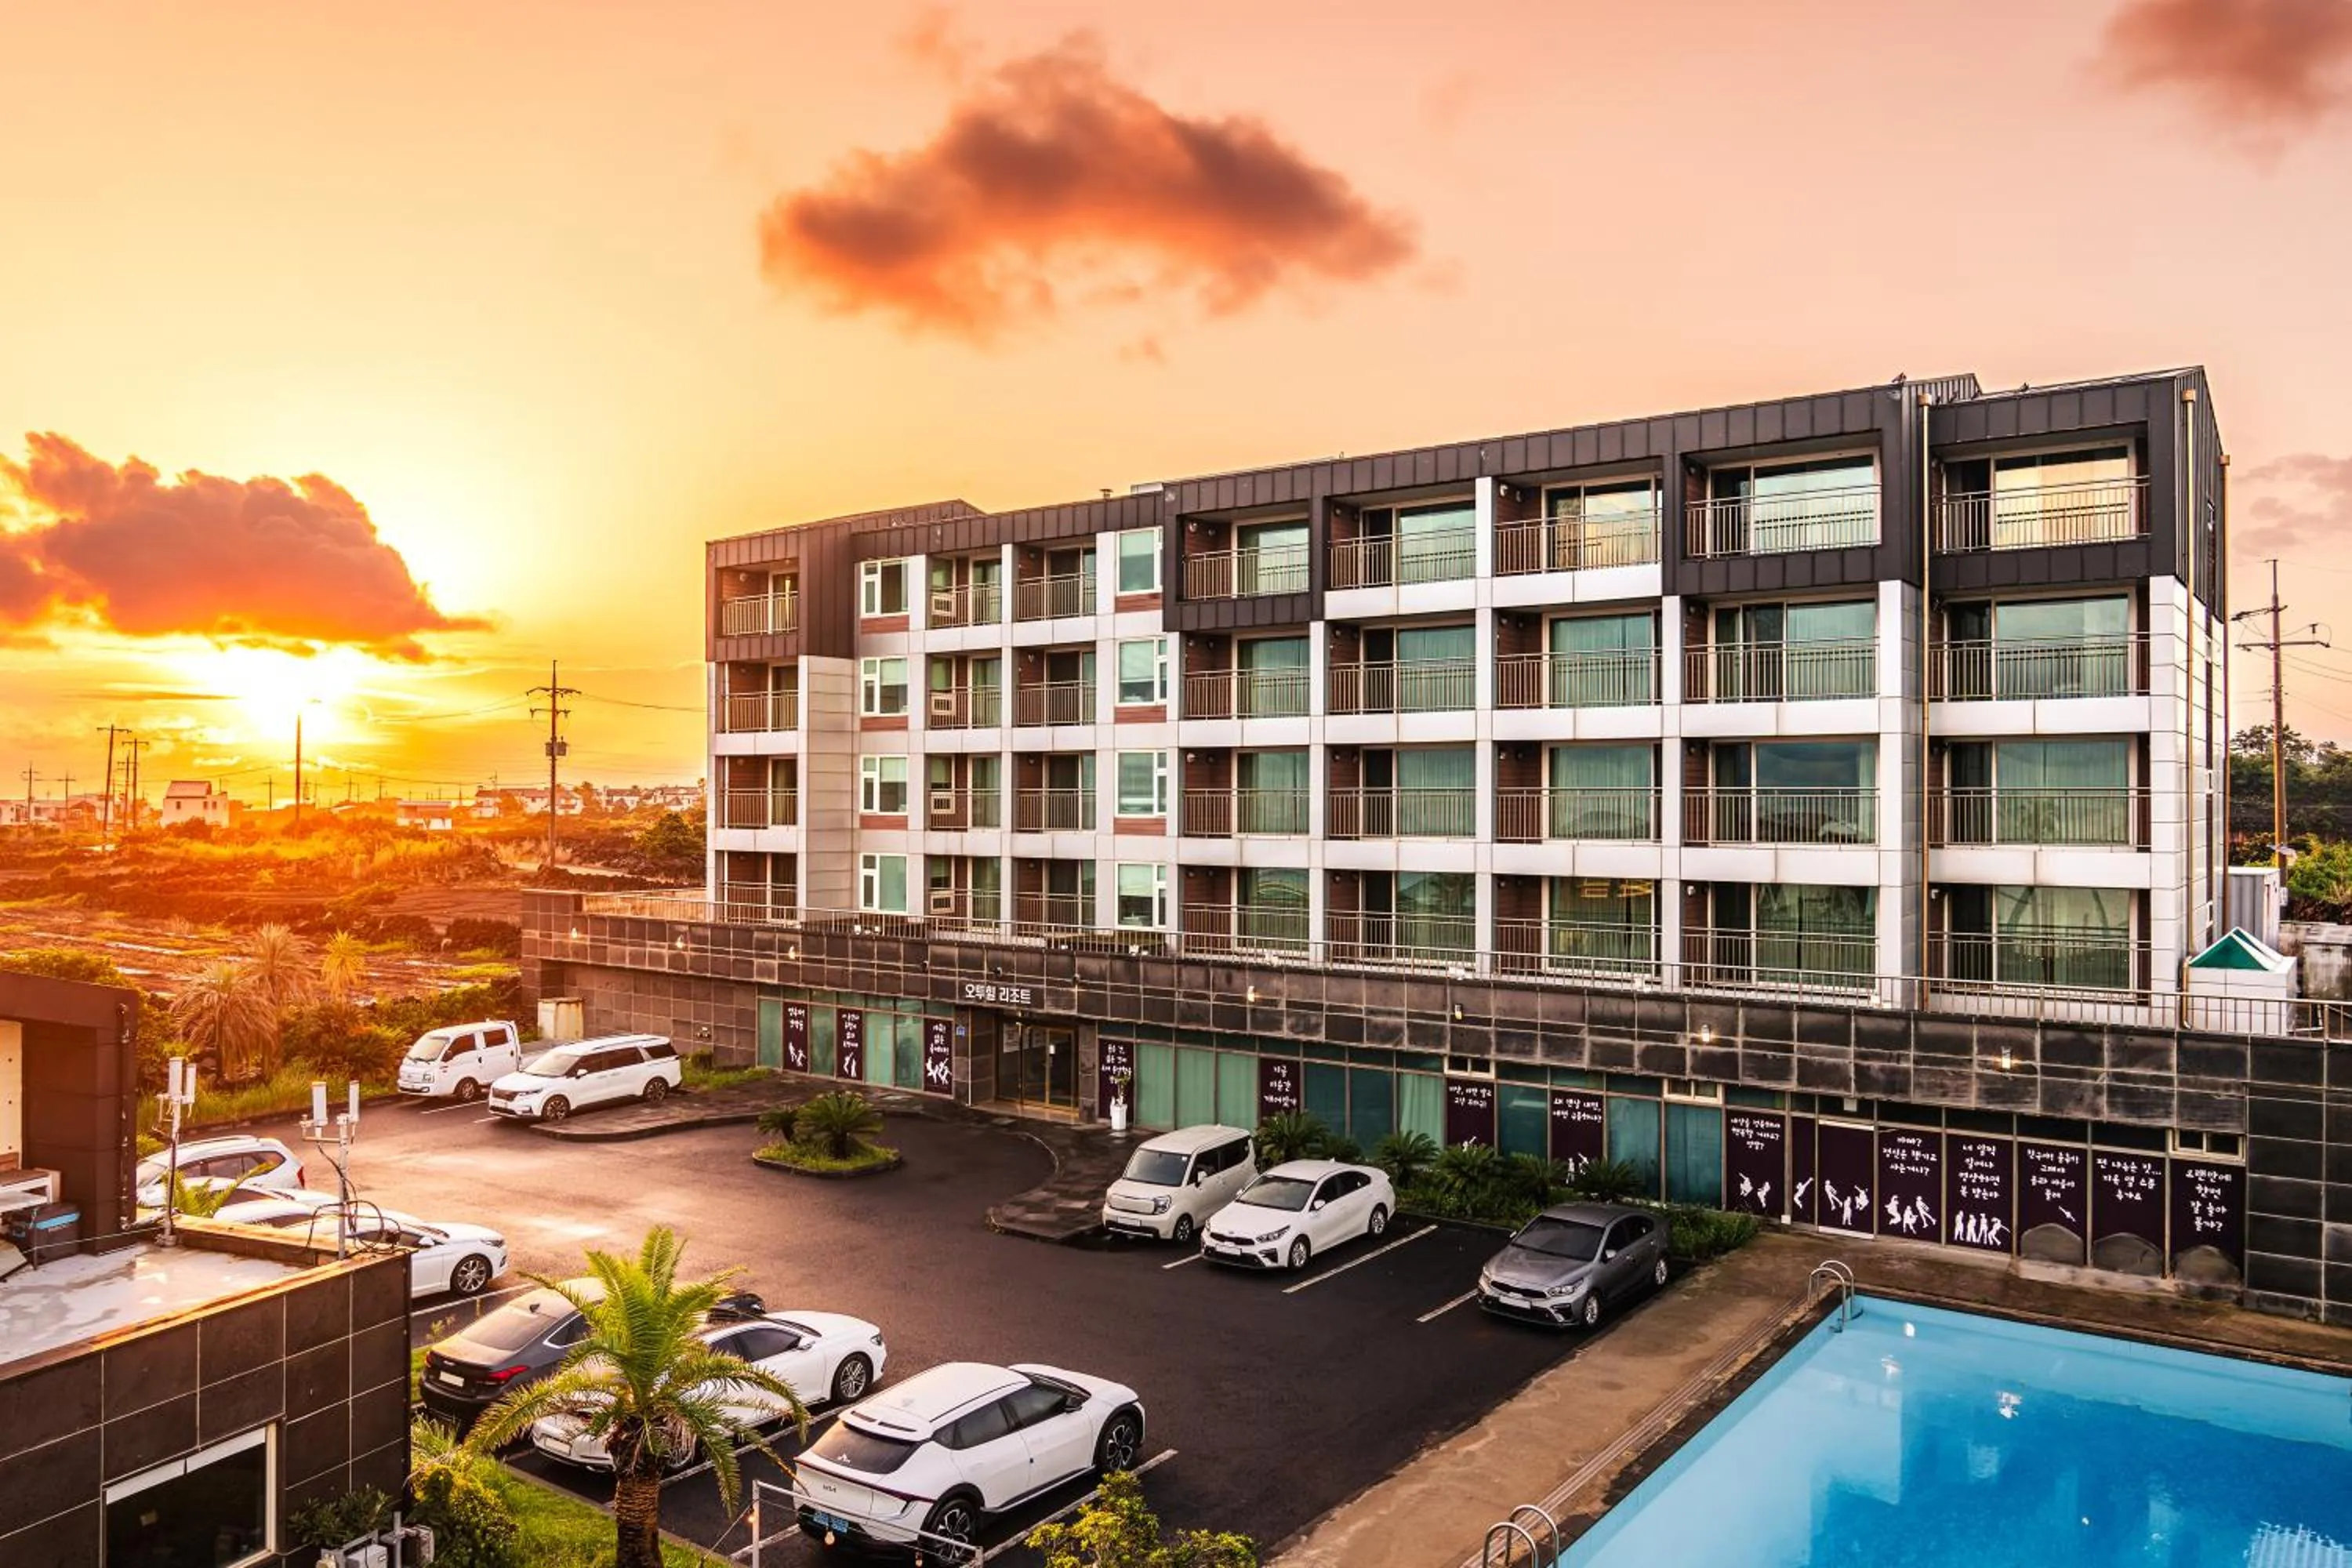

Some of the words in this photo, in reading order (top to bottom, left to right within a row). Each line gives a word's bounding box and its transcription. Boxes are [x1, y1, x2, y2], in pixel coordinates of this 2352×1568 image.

[999, 987, 1031, 1004] 리조트
[1964, 1156, 1994, 1170] 일어나
[1958, 1172, 2000, 1186] 명상하면
[2185, 1169, 2232, 1183] 오랜만에
[2194, 1183, 2221, 1200] 한번
[2190, 1200, 2202, 1214] 잘
[2206, 1202, 2227, 1218] 놀아
